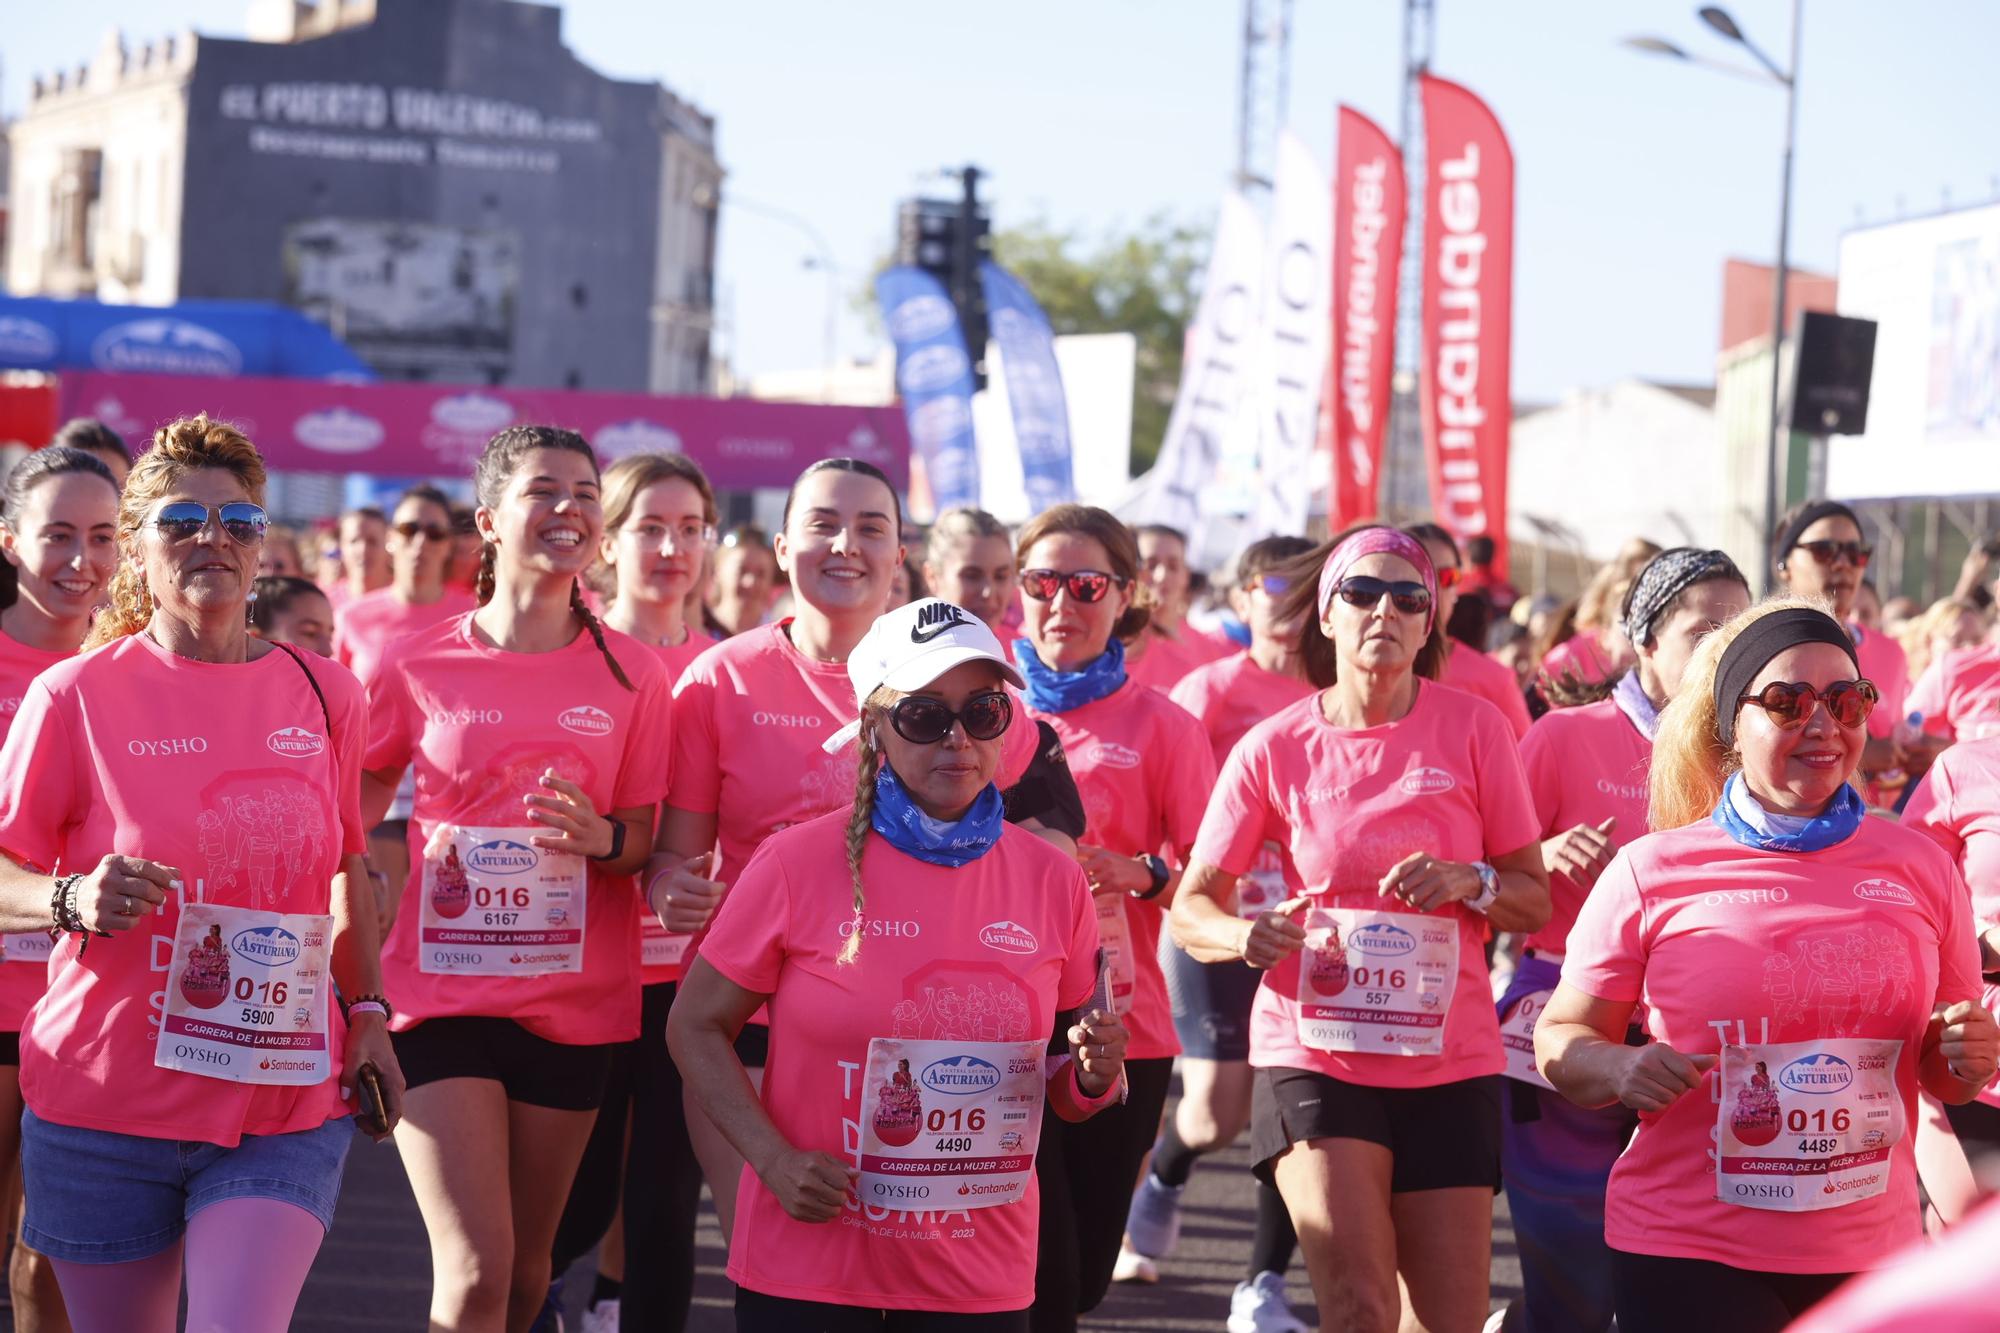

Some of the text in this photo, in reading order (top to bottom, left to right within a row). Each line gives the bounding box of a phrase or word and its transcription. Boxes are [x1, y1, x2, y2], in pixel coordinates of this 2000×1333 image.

[261, 82, 387, 130] PUERTO
[918, 604, 962, 629] NIKE
[434, 709, 502, 726] OYSHO
[563, 714, 610, 731] ASTURIANA
[753, 711, 821, 728] OYSHO
[128, 737, 208, 756] OYSHO
[273, 738, 322, 750] ASTURIANA
[1405, 777, 1450, 791] ASTURIANA
[1597, 779, 1648, 800] OYSH
[471, 855, 533, 867] ASTURIANA
[475, 887, 530, 907] 016
[1704, 887, 1788, 907] OYSHO
[1860, 884, 1912, 902] ASTURIANA
[484, 913, 519, 926] 6167
[304, 938, 322, 947] SUMA
[438, 932, 481, 942] CARRERA
[483, 933, 497, 942] DE
[499, 933, 511, 942] LA
[513, 933, 545, 942] MUJER
[984, 931, 1035, 950] ASTURIANA
[1353, 935, 1411, 950] ASTURIANA
[1423, 935, 1450, 944] SUMA
[19, 939, 51, 951] OYS
[238, 936, 296, 958] ASTURIANA
[644, 944, 680, 955] YSHO
[434, 952, 482, 965] OYSHO
[523, 953, 570, 962] Santander
[1353, 967, 1406, 989] 016
[235, 977, 288, 1005] 016
[1366, 992, 1390, 1005] 557
[241, 1008, 275, 1026] 5900
[1315, 1009, 1358, 1019] CARRERA
[1359, 1011, 1372, 1020] DE
[1374, 1013, 1386, 1021] LA
[1387, 1014, 1418, 1024] MUJER
[184, 1022, 311, 1046] CARRERA DE LA MUJER 2023
[1311, 1028, 1357, 1041] OYSHO
[175, 1044, 231, 1066] OYSHO
[270, 1058, 317, 1071] Santander
[1007, 1064, 1037, 1074] SUMA
[1858, 1061, 1886, 1070] SUMA
[928, 1069, 995, 1085] ASTURIANA
[1786, 1069, 1849, 1085] ASTURIANA
[927, 1108, 986, 1132] 016
[1787, 1108, 1850, 1132] 016
[936, 1138, 972, 1152] 4490
[1799, 1139, 1838, 1153] 4489
[880, 1159, 1021, 1172] CARRERA DE LA MUJER 2023
[1741, 1161, 1794, 1172] CARRERA
[1795, 1162, 1812, 1172] DE
[1813, 1162, 1827, 1171] LA
[1857, 1151, 1878, 1163] 2023
[971, 1182, 1020, 1195] Santander
[1836, 1173, 1880, 1192] Santander
[873, 1183, 930, 1199] OYSHO
[1735, 1184, 1794, 1198] OYSHO
[880, 1228, 894, 1237] DE
[895, 1231, 908, 1239] LA
[951, 1228, 975, 1239] 2023
